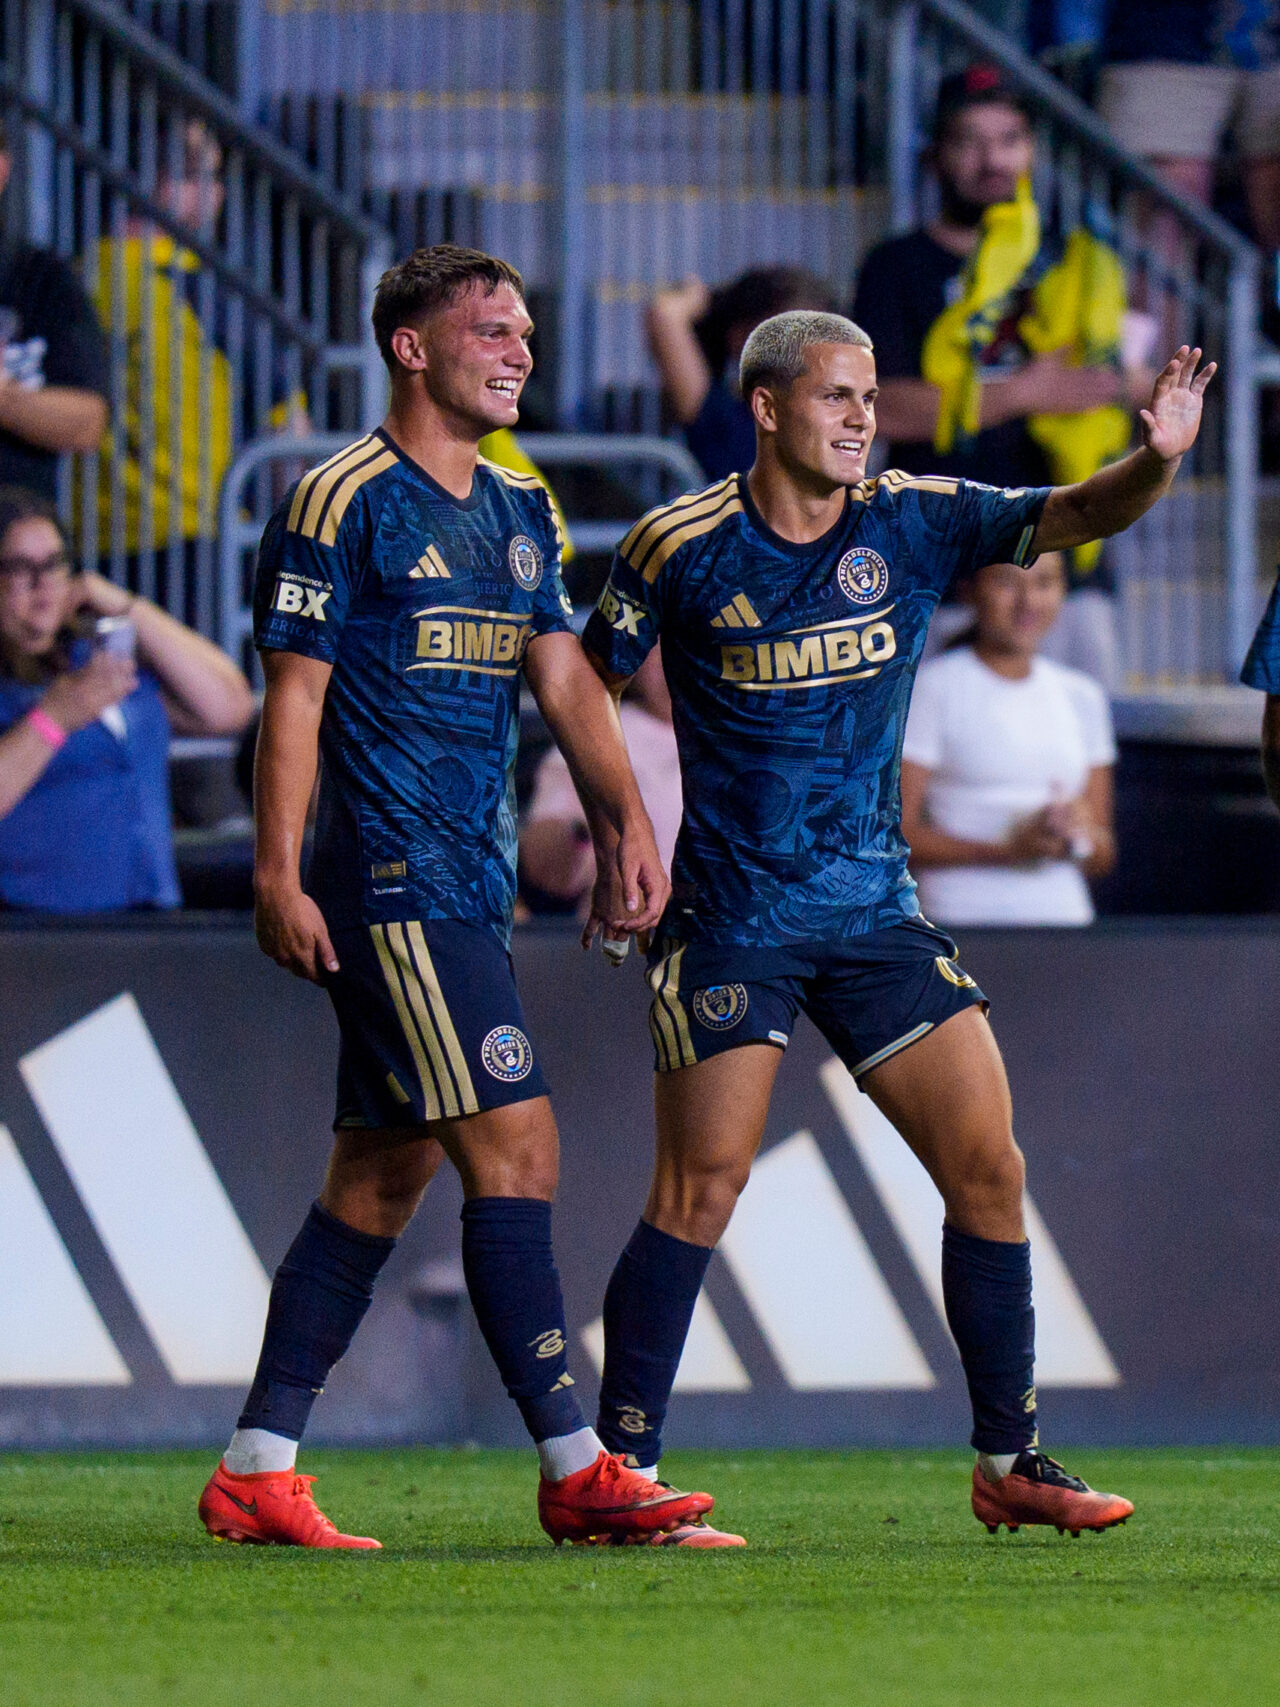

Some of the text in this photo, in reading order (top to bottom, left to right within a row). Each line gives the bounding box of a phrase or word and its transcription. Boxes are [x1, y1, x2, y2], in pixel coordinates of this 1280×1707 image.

[840, 550, 884, 581] PHILADELPHIA
[720, 621, 897, 682] BIMBO
[484, 1028, 527, 1058] PHILADELPHIA
